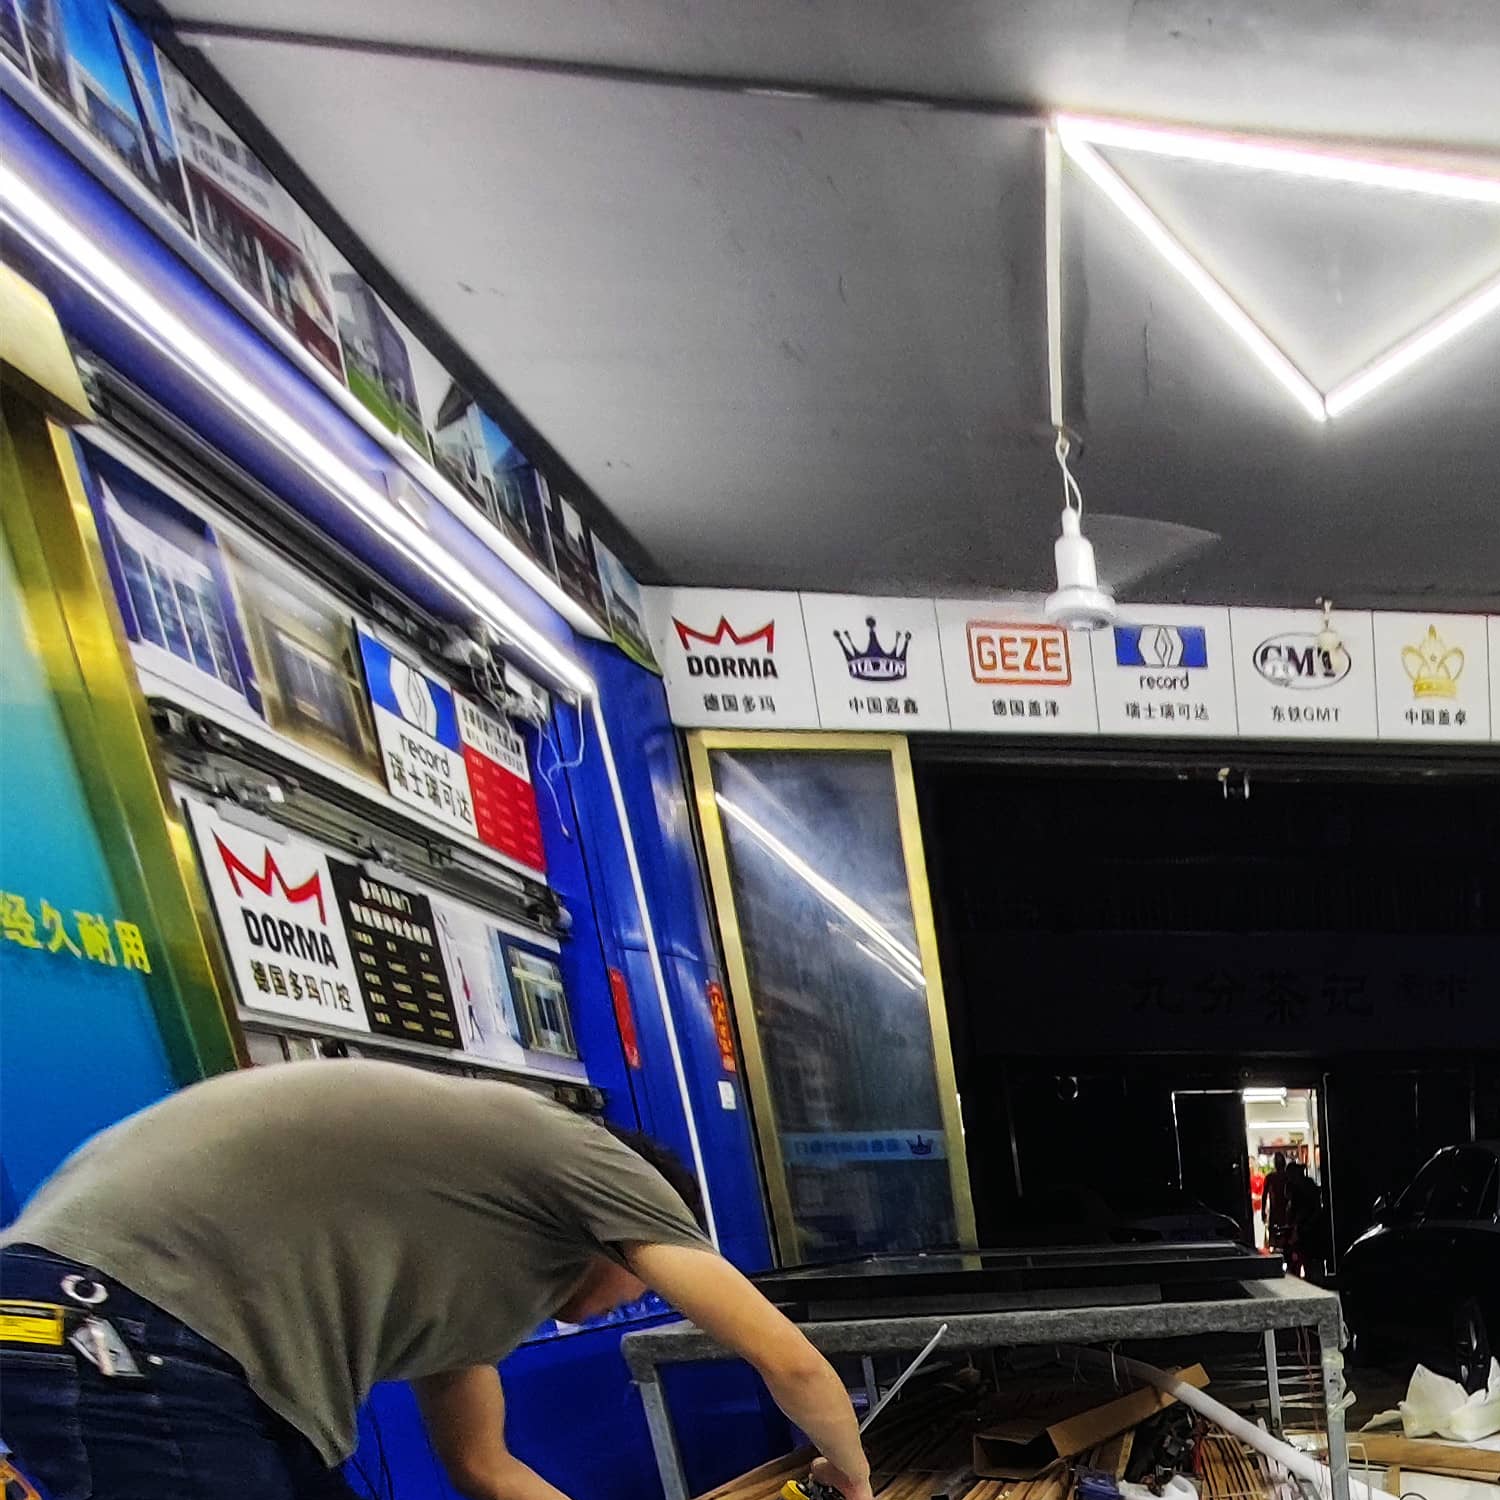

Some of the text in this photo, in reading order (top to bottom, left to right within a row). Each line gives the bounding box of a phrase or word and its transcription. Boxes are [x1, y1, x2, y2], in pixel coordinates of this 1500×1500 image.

[686, 655, 779, 679] DORMA
[976, 636, 1062, 673] GEZE
[1139, 672, 1190, 690] record
[703, 693, 777, 714] 德国多玛
[1125, 701, 1210, 721] 瑞士瑞可达
[400, 734, 450, 778] record
[388, 751, 473, 825] 瑞士瑞可达
[0, 888, 152, 975] 经久耐用
[241, 907, 338, 969] DORMA
[250, 959, 354, 1013] 德国多玛门控
